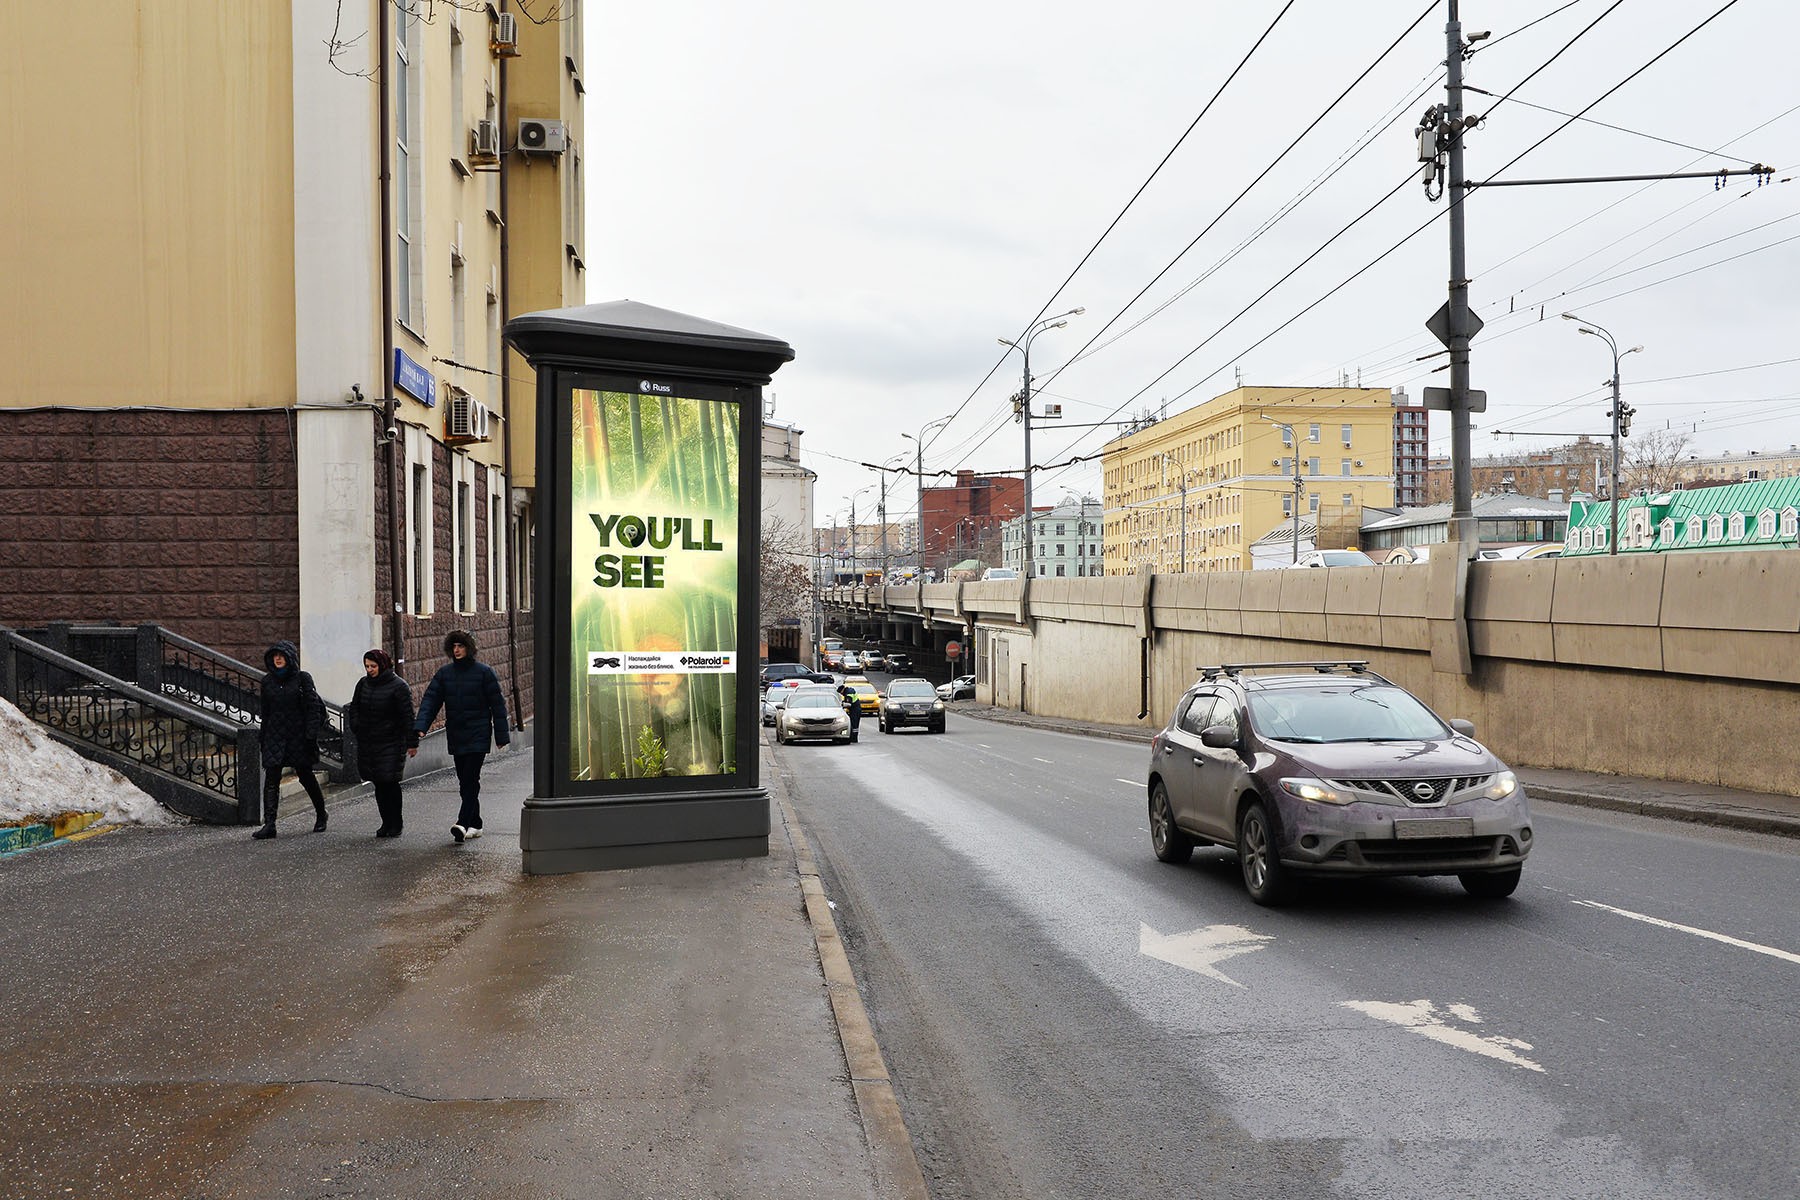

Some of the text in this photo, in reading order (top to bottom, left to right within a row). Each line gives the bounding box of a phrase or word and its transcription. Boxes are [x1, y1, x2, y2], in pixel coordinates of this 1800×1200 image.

[652, 383, 671, 392] Russ
[593, 554, 664, 588] SEE
[687, 656, 722, 665] Polaroid
